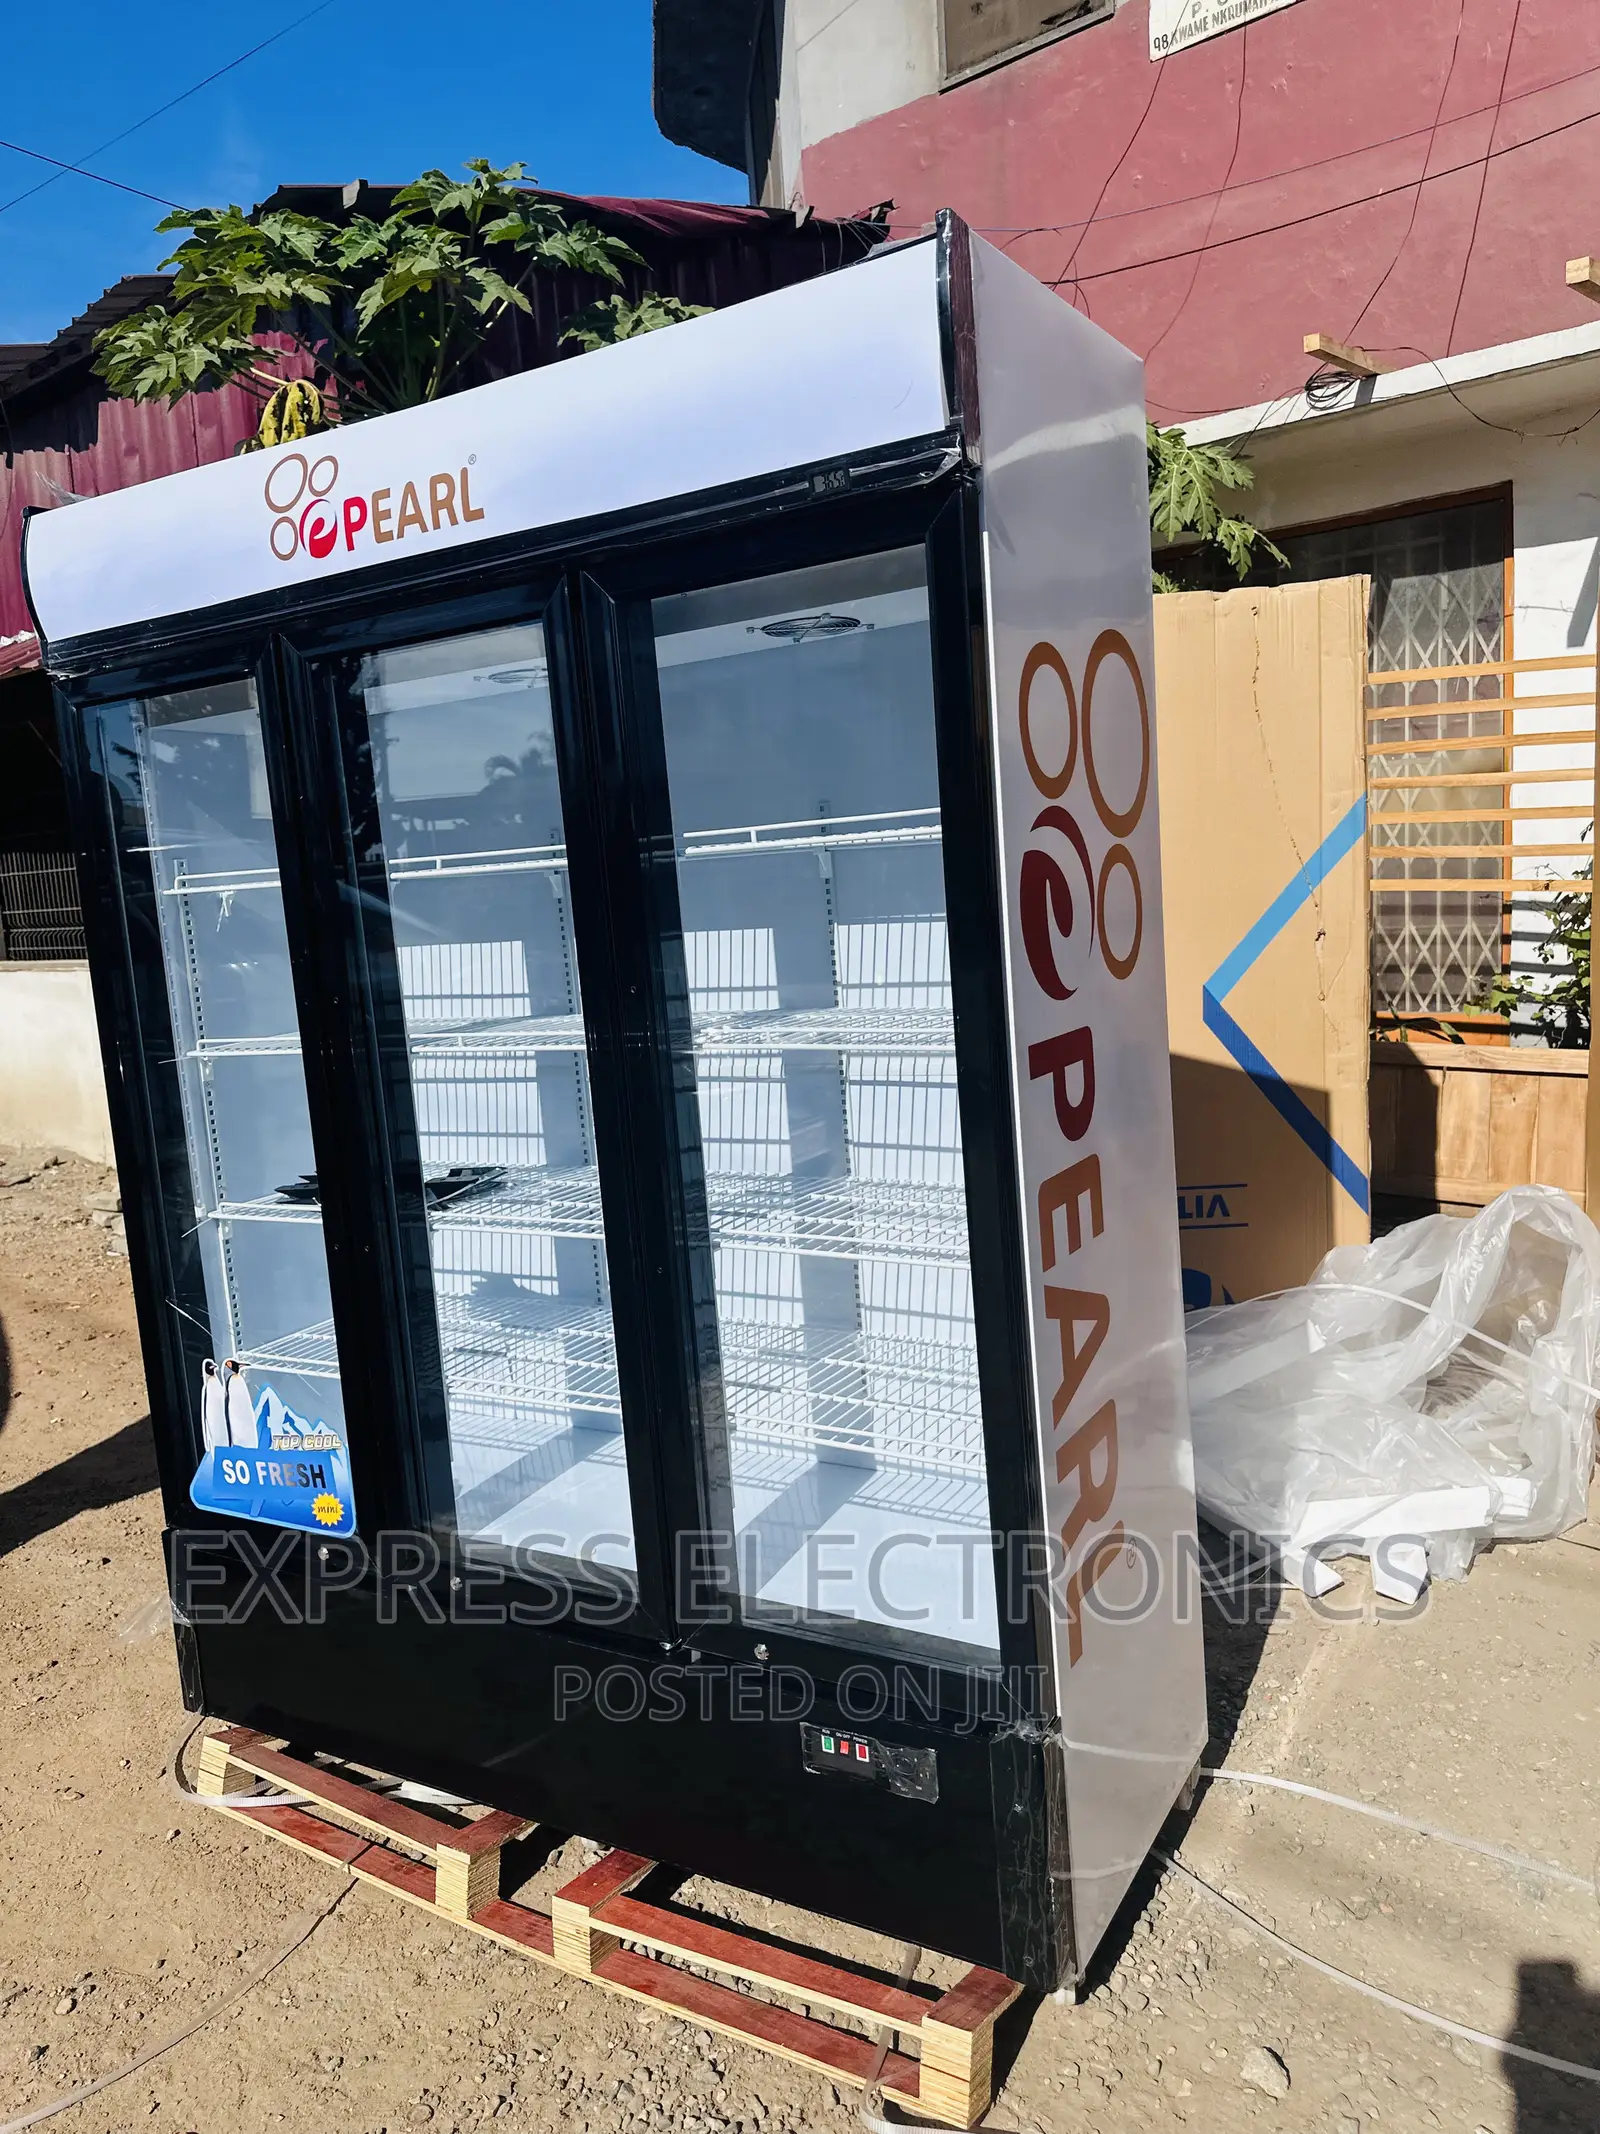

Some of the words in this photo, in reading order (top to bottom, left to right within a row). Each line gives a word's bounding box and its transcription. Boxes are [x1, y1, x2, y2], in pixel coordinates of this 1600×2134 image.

[1153, 34, 1169, 51] 98
[1170, 16, 1209, 46] KWAME
[272, 1433, 300, 1450] TOP
[302, 1434, 343, 1450] COOL
[221, 1459, 251, 1485] SO
[255, 1461, 327, 1489] FRESH
[317, 1502, 338, 1514] mini
